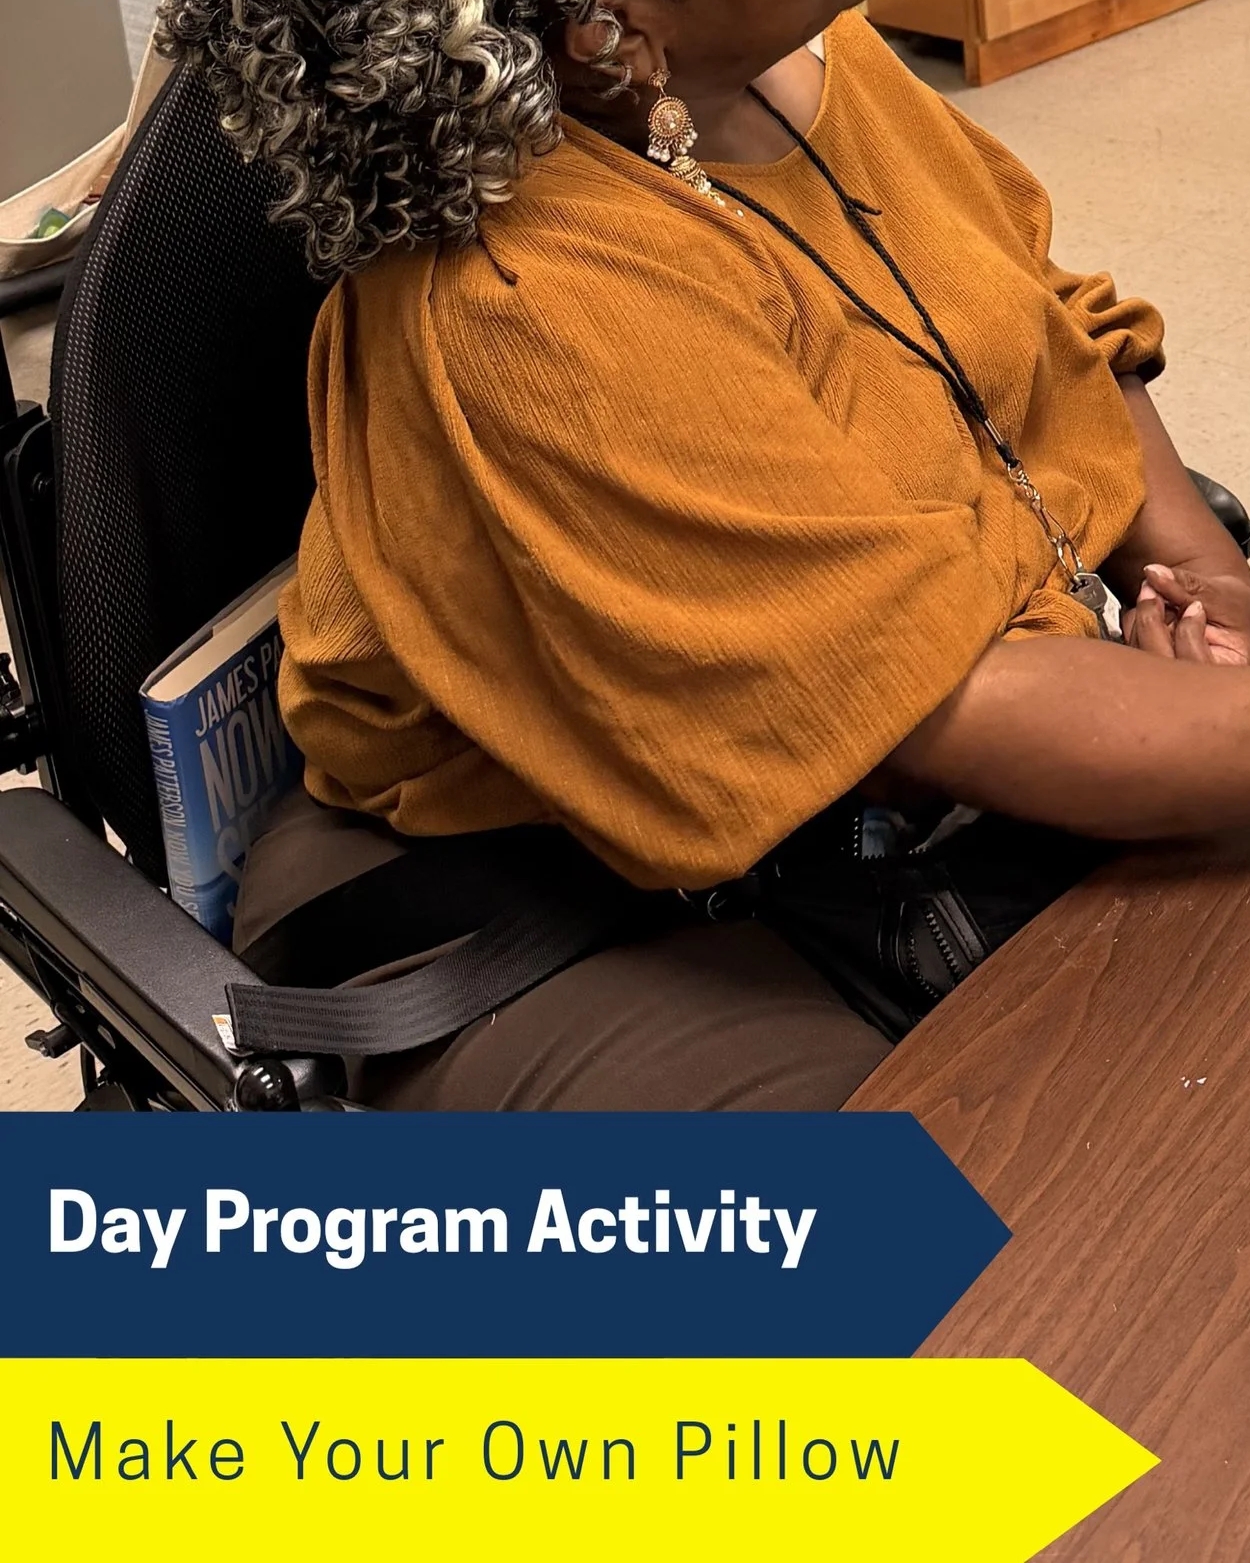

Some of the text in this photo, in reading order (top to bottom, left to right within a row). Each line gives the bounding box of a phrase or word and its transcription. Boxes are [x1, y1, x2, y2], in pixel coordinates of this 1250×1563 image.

[194, 654, 259, 738] JAMES
[144, 709, 174, 755] JAMES
[199, 687, 287, 834] NOW
[152, 756, 186, 826] PATTERSON
[166, 830, 190, 863] NOW
[173, 867, 195, 895] YOU
